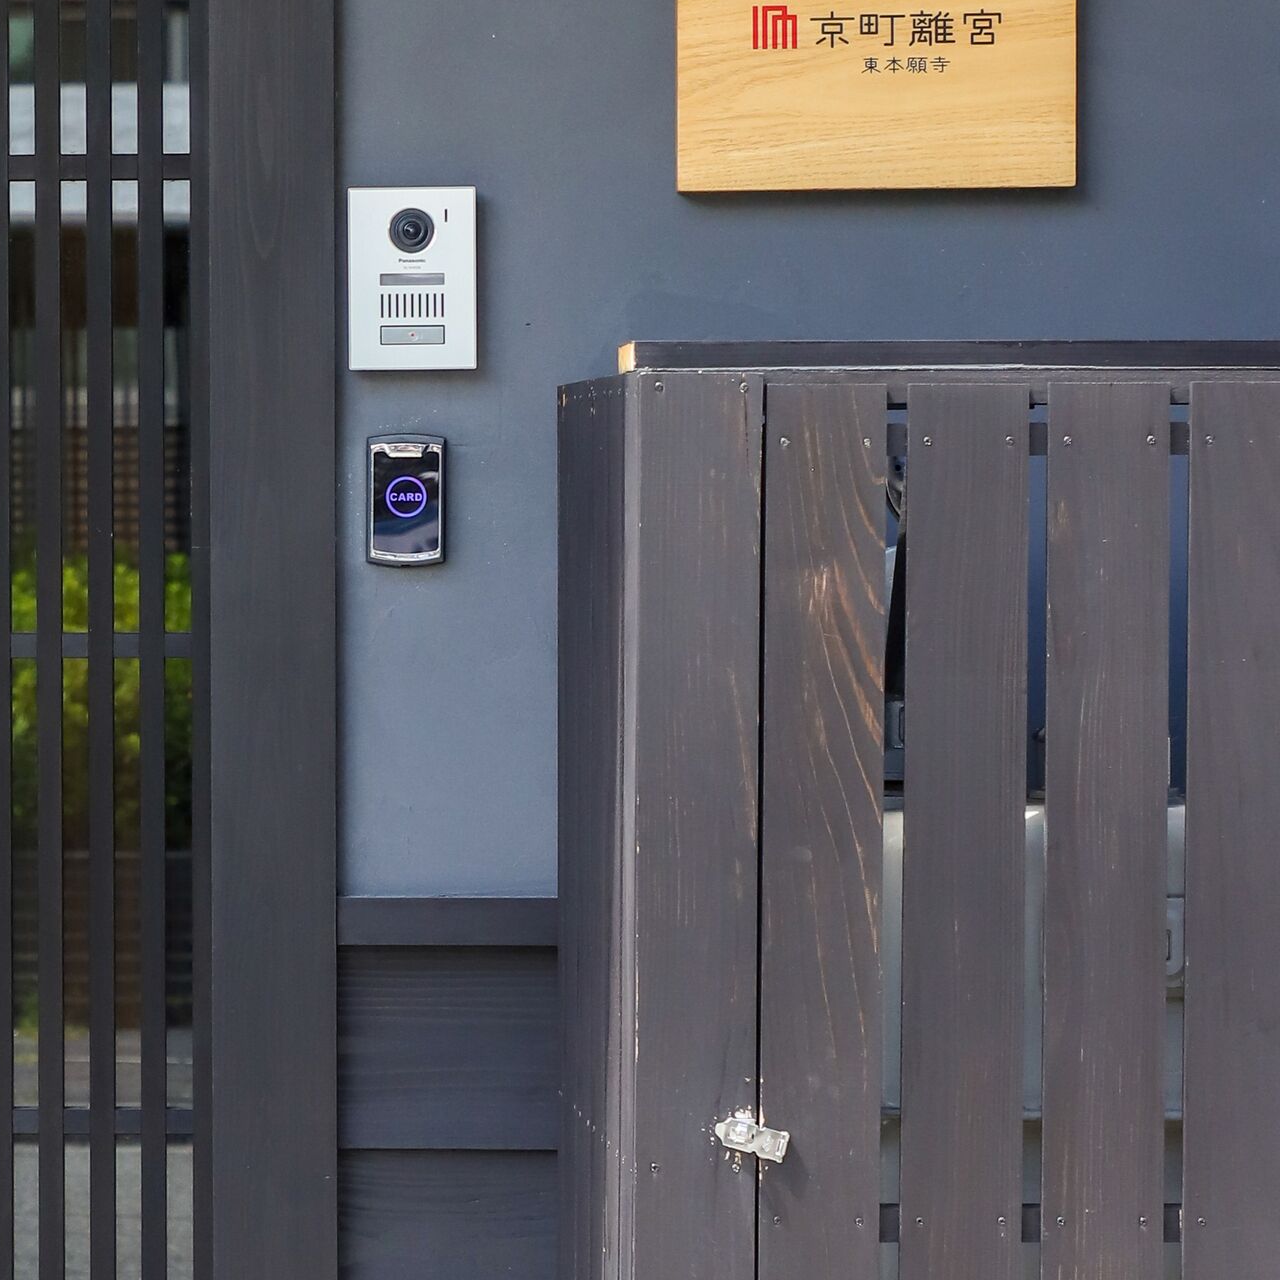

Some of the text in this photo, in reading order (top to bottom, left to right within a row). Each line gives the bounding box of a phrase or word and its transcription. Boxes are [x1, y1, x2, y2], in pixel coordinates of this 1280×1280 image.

[810, 9, 1002, 48] 京町離宮
[861, 56, 951, 73] 東本願寺
[390, 492, 423, 502] CARD
